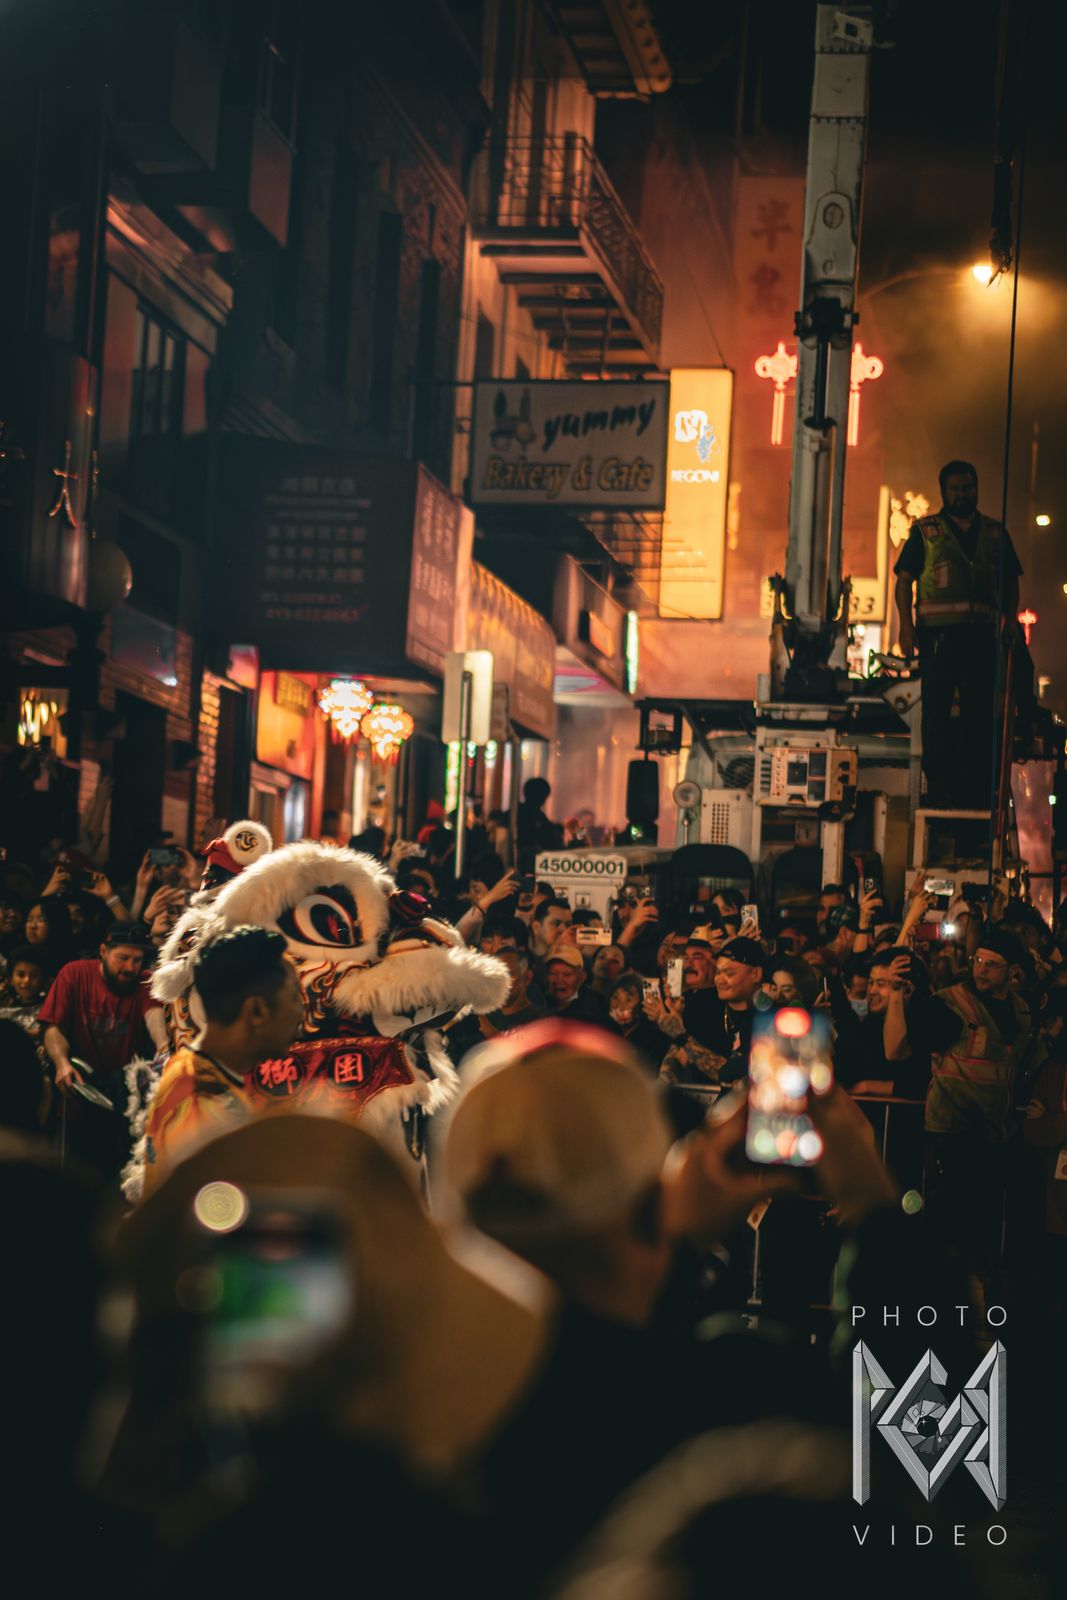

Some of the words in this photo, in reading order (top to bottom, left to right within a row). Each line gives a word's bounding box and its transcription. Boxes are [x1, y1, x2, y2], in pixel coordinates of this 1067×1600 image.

[542, 398, 655, 453] yummy
[481, 454, 571, 500] Bakery
[571, 454, 594, 491] &
[597, 455, 655, 492] Cafe
[539, 857, 624, 875] 45000001
